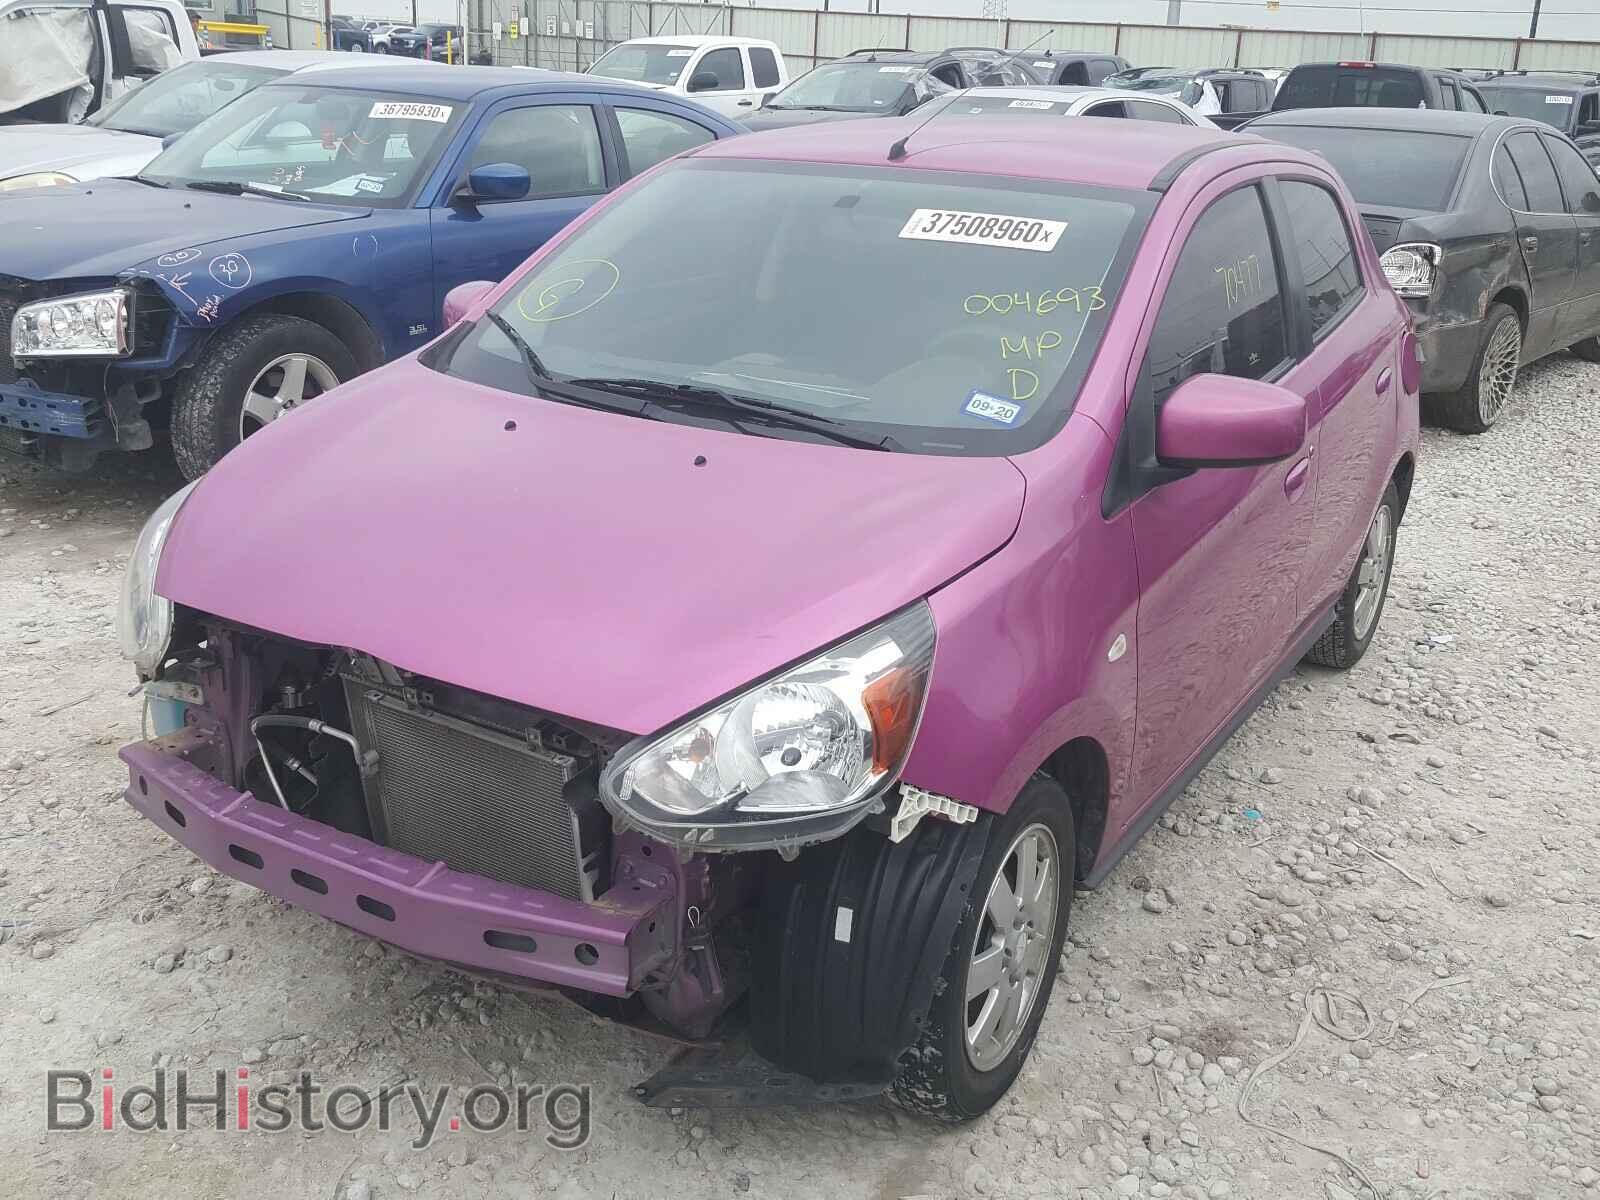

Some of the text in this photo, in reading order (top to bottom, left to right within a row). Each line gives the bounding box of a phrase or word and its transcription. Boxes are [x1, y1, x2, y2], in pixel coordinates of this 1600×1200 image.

[964, 286, 1107, 315] 004693
[1000, 331, 1063, 361] MP
[1007, 368, 1039, 400] D
